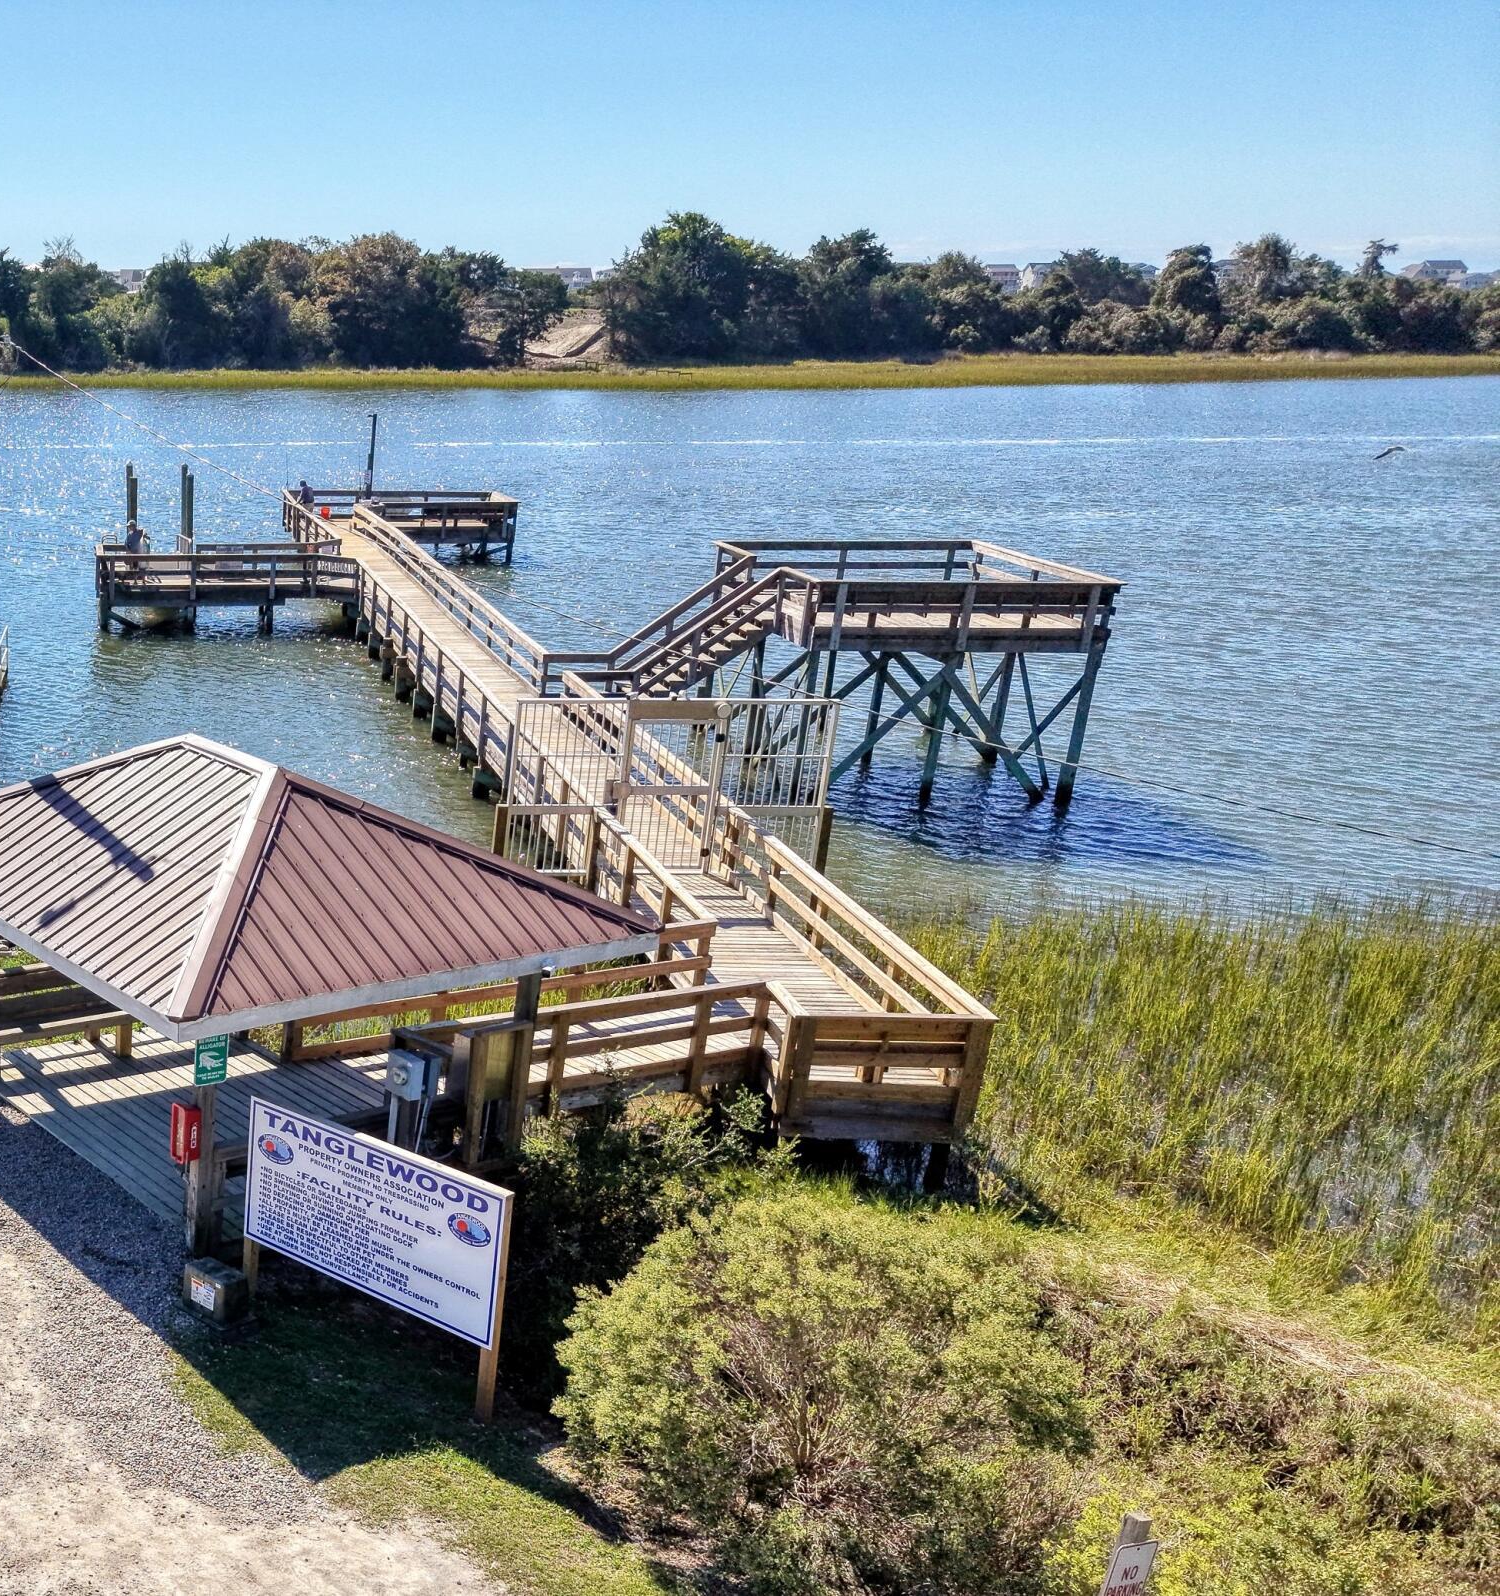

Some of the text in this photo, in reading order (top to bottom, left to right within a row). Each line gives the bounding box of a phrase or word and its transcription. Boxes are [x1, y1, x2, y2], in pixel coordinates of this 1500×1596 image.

[199, 1041, 225, 1049] ALLIGATOR
[262, 1109, 489, 1215] TANGLEWOOD
[298, 1142, 342, 1167] PROPERTY
[344, 1161, 380, 1183] OWNERS
[383, 1177, 444, 1209] ASSOCIATION
[310, 1157, 335, 1173] PRIVATE
[337, 1168, 370, 1187] PROPERTY
[372, 1182, 382, 1192] NO
[384, 1187, 429, 1211] TRESPASSING
[262, 1185, 369, 1236] NO DEFACING OR DAMAGING PIER
[262, 1178, 413, 1248] NO PLAYING OR SUNNING ON FLOATING DOCK
[263, 1165, 366, 1215] NO BICYCLES OR SKATEBOARDS
[263, 1172, 272, 1181] NO
[311, 1192, 334, 1208] DIVING
[336, 1203, 345, 1213] OR
[347, 1208, 378, 1227] JUMPING
[380, 1222, 399, 1236] FROM
[401, 1231, 418, 1244] PIER
[342, 1179, 392, 1205] MEMBERS ONLY
[260, 1210, 409, 1281] PLEASE BE RESPECTFUL TO OTHER MEMBERS
[261, 1204, 375, 1259] PLEASE CLEAN UP AFTER YOUR PET
[261, 1197, 480, 1299] ALL PETS MUST BE LEASHED AND UNDER THE OWNERS CONTROL
[262, 1191, 270, 1200] NO
[310, 1212, 337, 1229] PARTIES
[339, 1225, 349, 1234] OR
[351, 1230, 369, 1243] LOUD
[371, 1239, 393, 1254] MUSIC
[379, 1204, 441, 1238] RULES:
[260, 1216, 407, 1287] PIER DOOR TO REMAIN LOCKED AT ALL TIMES
[260, 1229, 369, 1284] AREA UNDER VIDEO SURVEILLANCE
[260, 1222, 272, 1233] USE
[274, 1228, 281, 1237] AT
[283, 1233, 298, 1244] OWN
[318, 1249, 332, 1260] NOT
[334, 1256, 380, 1282] RESPONSIBLE
[382, 1278, 396, 1289] FOR
[398, 1285, 438, 1309] ACCIDENTS
[1106, 1581, 1143, 1596] PARKING
[1121, 1566, 1138, 1581] NO
